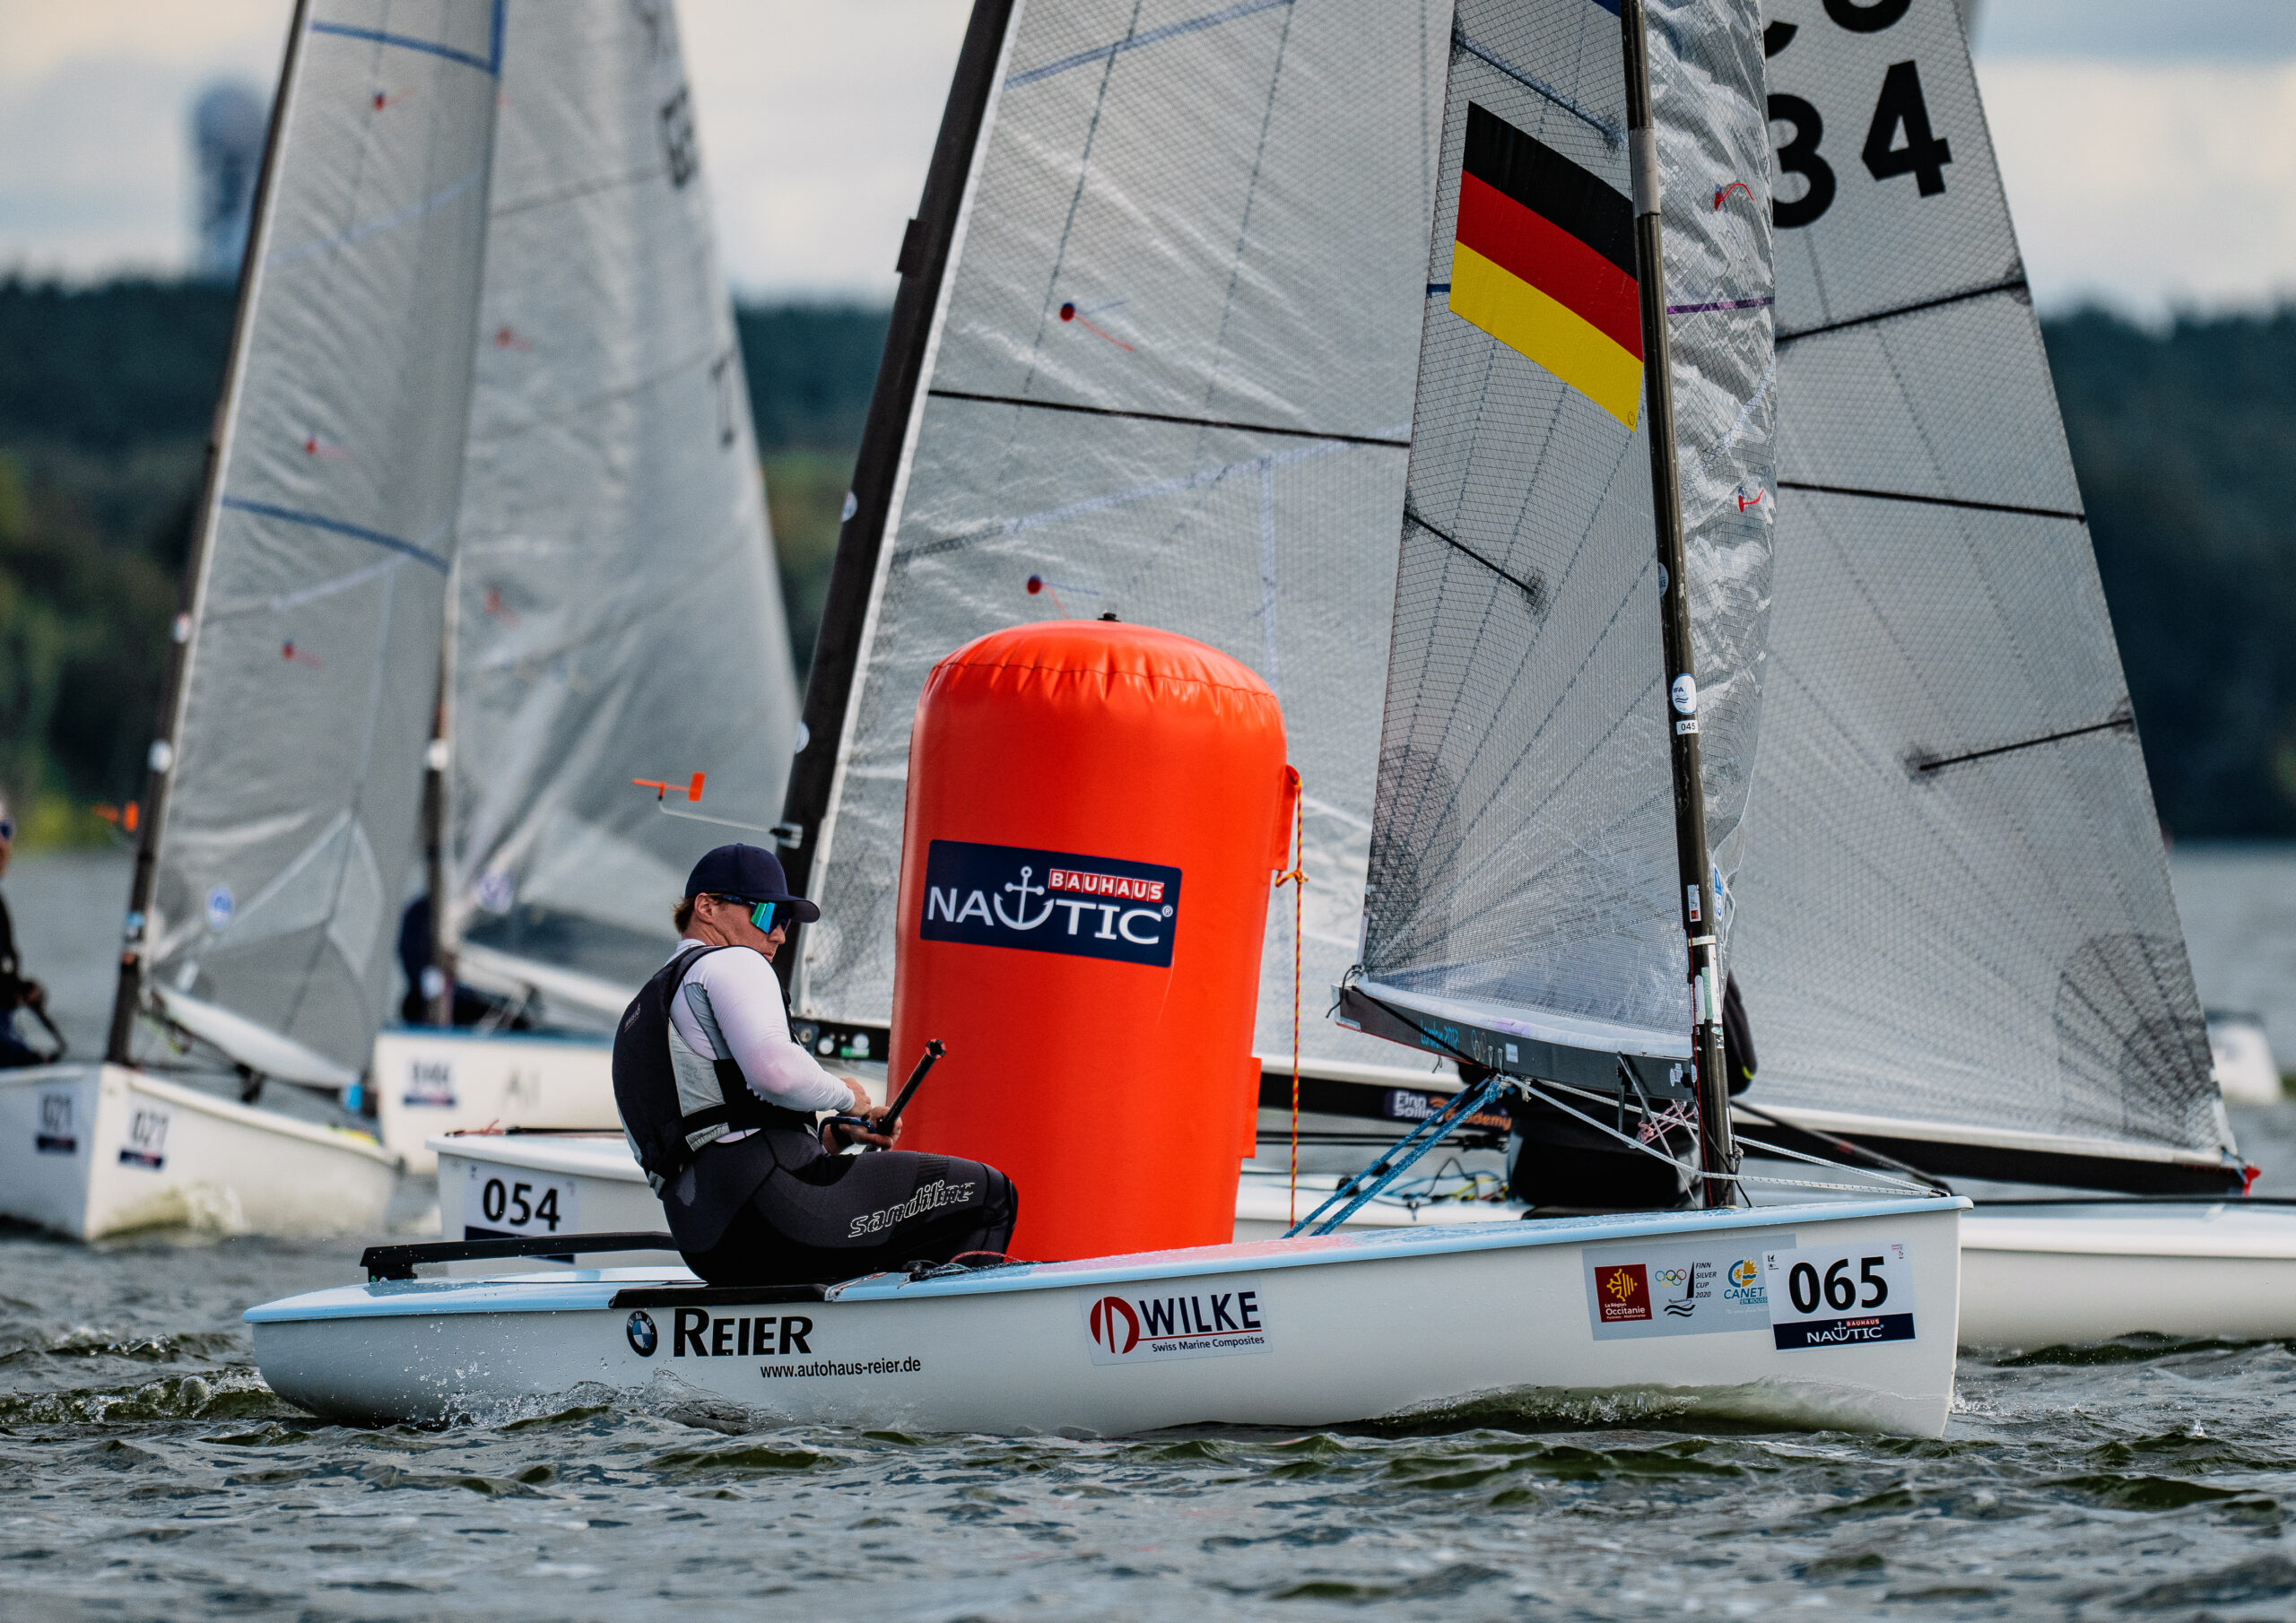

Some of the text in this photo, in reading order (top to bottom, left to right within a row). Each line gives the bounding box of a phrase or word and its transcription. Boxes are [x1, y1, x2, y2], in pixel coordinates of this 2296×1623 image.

[1681, 722, 1696, 731] 045
[1051, 871, 1164, 901] BAUHAUS
[1395, 1091, 1426, 1106] Finn
[483, 1178, 561, 1232] 054
[1724, 1287, 1765, 1299] CANET
[1788, 1256, 1888, 1314] 065
[1139, 1291, 1262, 1336] WILKE
[1605, 1306, 1646, 1315] Occitanie
[1847, 1319, 1880, 1327] BAUHAUS
[1152, 1335, 1265, 1352] Swiss Marine Composites
[761, 1356, 922, 1378] www.autohaus-reier.de
